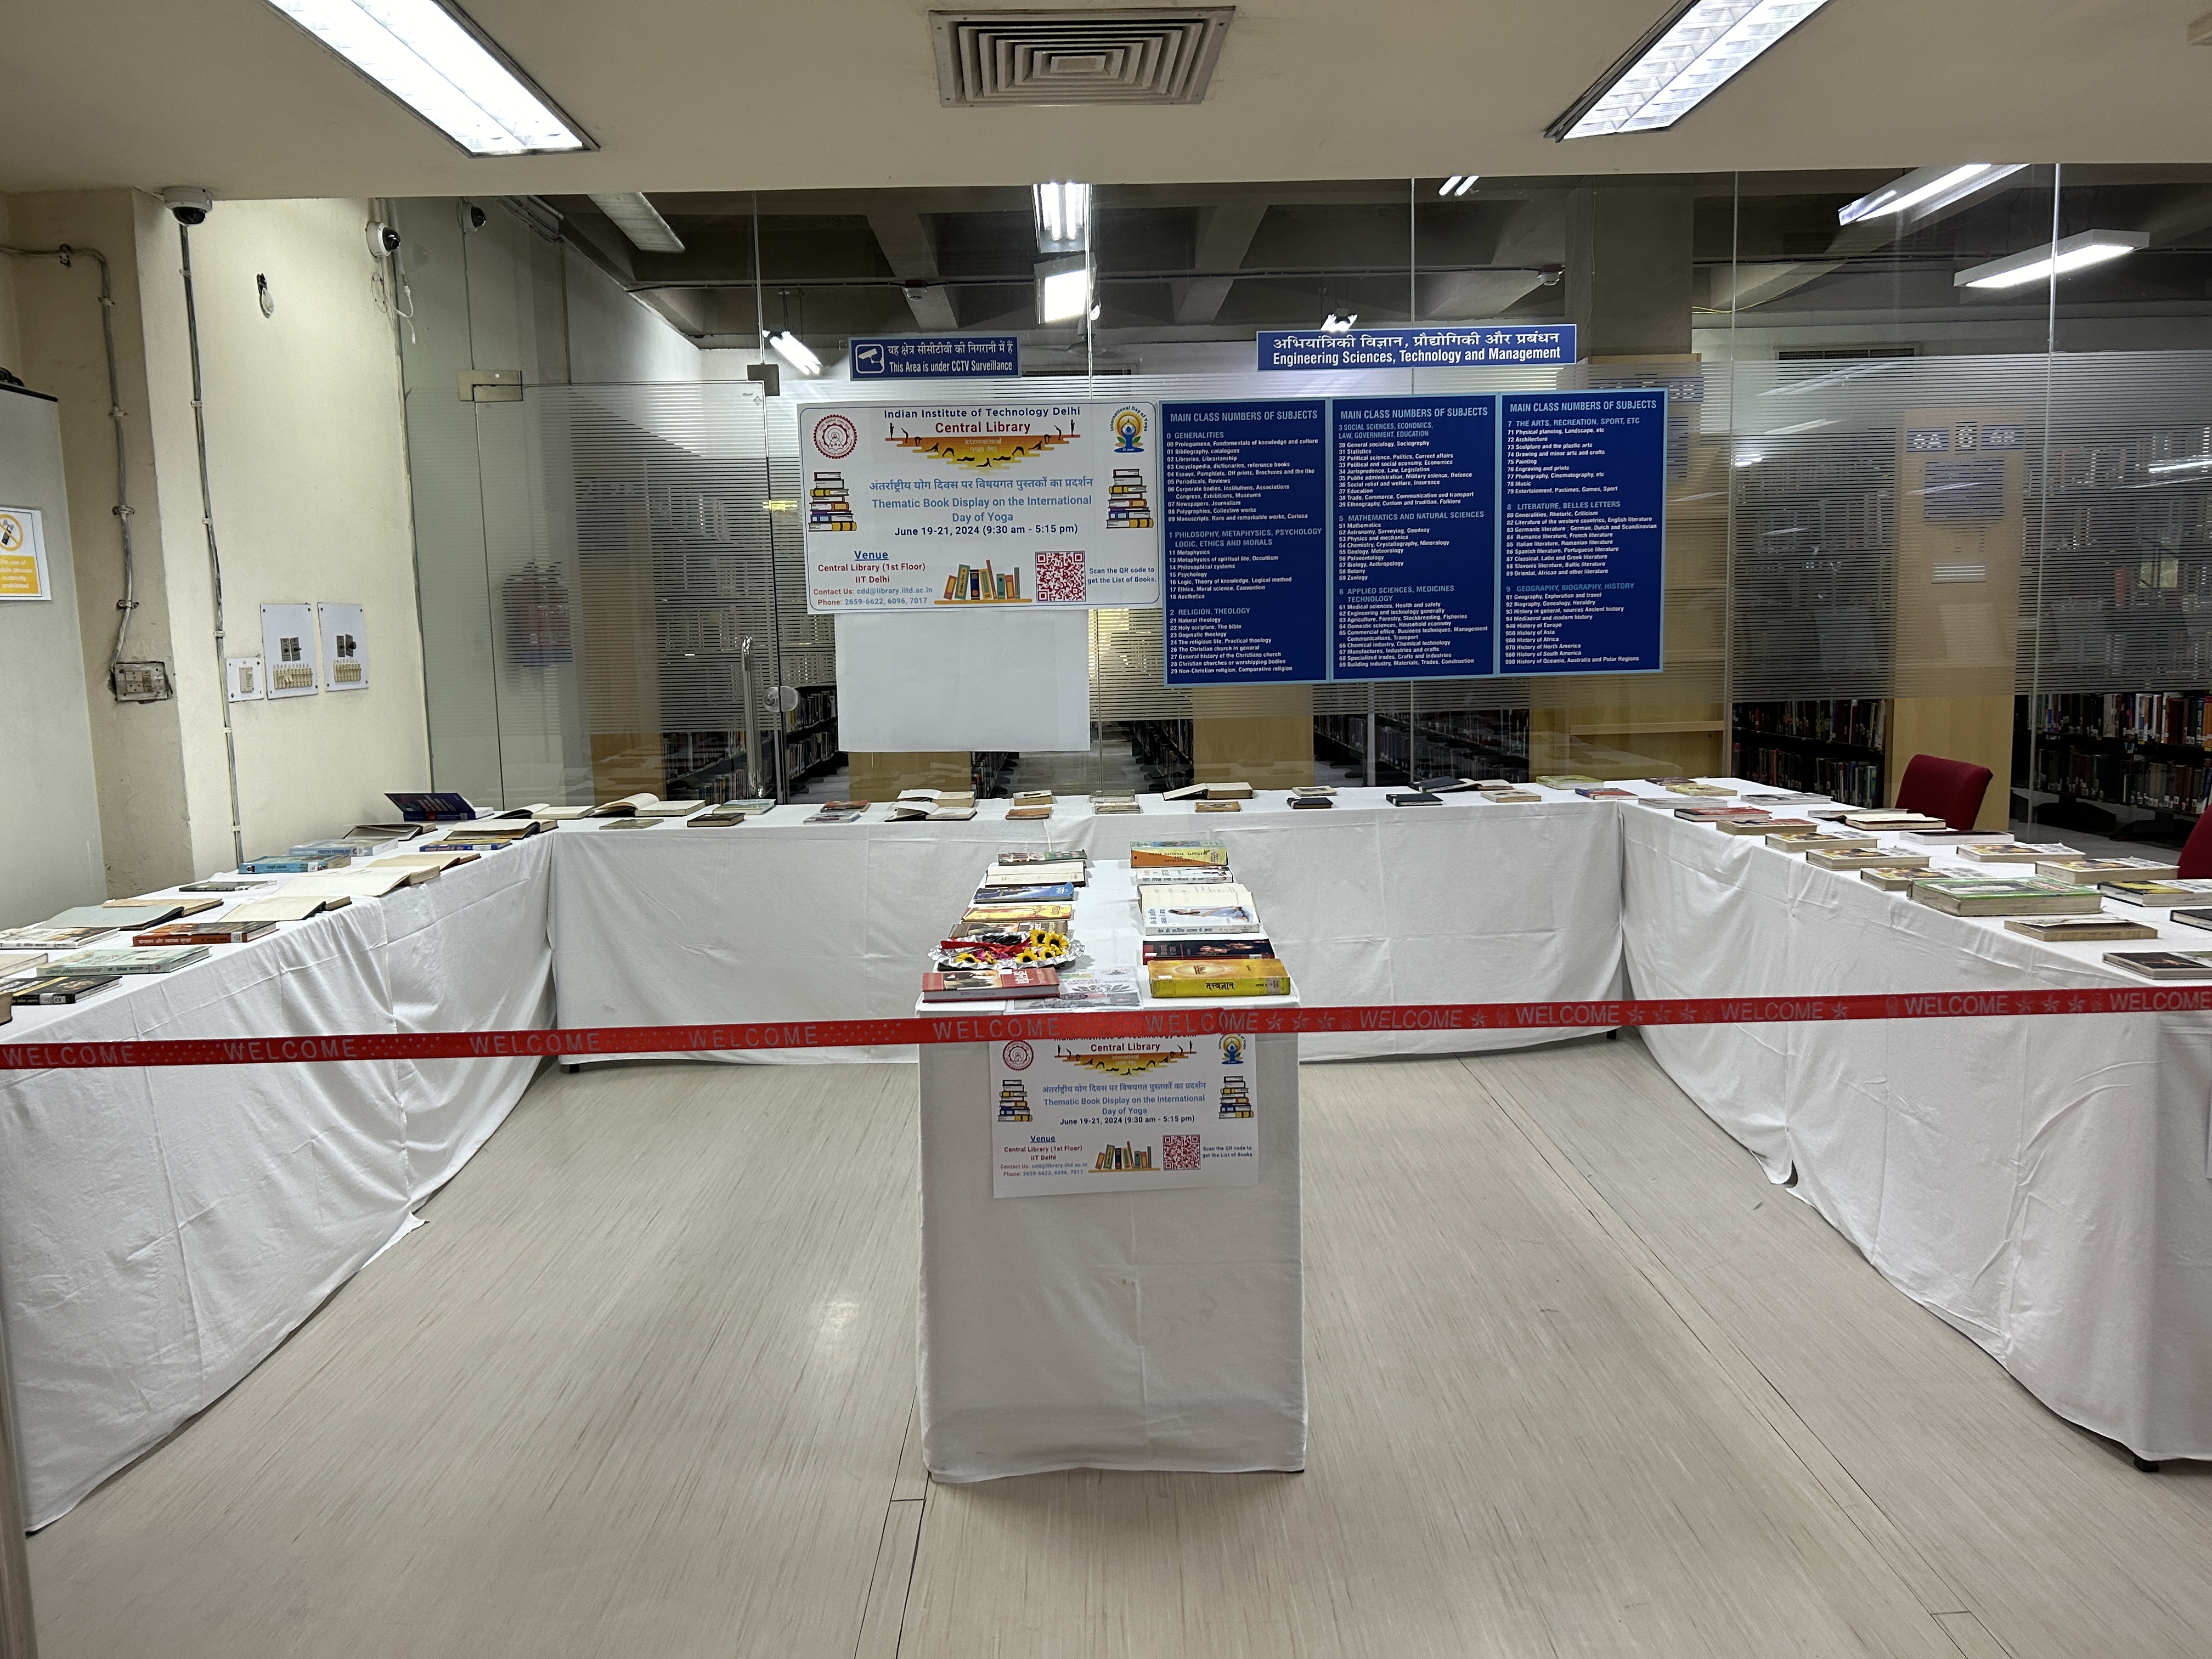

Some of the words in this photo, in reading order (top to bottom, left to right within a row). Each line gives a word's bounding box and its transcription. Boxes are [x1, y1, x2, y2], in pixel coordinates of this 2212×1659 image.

[1273, 335, 1356, 348] अभियांत्रिकी
[1412, 331, 1481, 346] प्रौद्योगिकी
[1485, 331, 1512, 344] और
[1515, 331, 1560, 343] प्रबंधन
[887, 346, 899, 356] यह
[901, 342, 915, 356] क्षेत्र
[916, 341, 952, 354] सीसीटीवी
[953, 341, 966, 353] की
[967, 341, 996, 353] निगरानी
[1272, 352, 1338, 366] Engineering
[1342, 351, 1395, 363] Sciences,
[1399, 349, 1462, 363] Technology
[1465, 348, 1485, 360] and
[1488, 347, 1560, 361] Management
[889, 362, 904, 373] This
[905, 362, 921, 372] Area
[922, 361, 929, 372] is
[930, 361, 950, 372] under
[951, 360, 969, 371] CCTV
[971, 360, 1012, 371] Surveillance
[1510, 403, 1531, 412] MAIN
[1533, 402, 1559, 411] CLASS
[1561, 401, 1601, 410] NUMBERS
[1603, 400, 1614, 410] OF
[1616, 400, 1656, 409] SUBJECTS
[884, 409, 917, 418] Indian
[922, 409, 967, 417] Institute
[970, 408, 981, 416] of
[985, 408, 1048, 417] Technology
[1053, 407, 1080, 415] Delhi
[1170, 413, 1191, 422] MAIN
[1193, 413, 1220, 422] CLASS
[1222, 411, 1261, 421] NUMBERS
[1264, 411, 1274, 420] OF
[1277, 410, 1318, 420] SUBJECTS
[1340, 410, 1361, 419] MAIN
[1364, 409, 1390, 419] CLASS
[1392, 408, 1432, 418] NUMBERS
[1434, 408, 1445, 417] OF
[1447, 407, 1488, 416] SUBJECTS
[935, 421, 981, 433] Central
[986, 421, 1030, 434] Library
[869, 479, 911, 492] अंतर्राष्ट्रीय
[913, 478, 931, 489] योग
[933, 478, 958, 489] दिवस
[961, 481, 973, 489] पर
[975, 478, 1013, 488] विषयगत
[1015, 476, 1047, 490] पुस्तकों
[1049, 479, 1063, 487] का
[1064, 476, 1093, 487] प्रदर्शन
[871, 499, 920, 508] Thematic
[923, 498, 949, 507] Book
[952, 497, 989, 509] Display
[1008, 496, 1024, 506] the
[1027, 495, 1091, 505] International
[952, 513, 971, 524] Day
[974, 512, 985, 522] of
[987, 512, 1013, 523] Yoga
[894, 527, 918, 535] June
[921, 527, 952, 536] 19-21,
[955, 526, 979, 534] 2024
[983, 525, 1007, 536] (9:30
[1035, 524, 1056, 533] 5:15
[1059, 523, 1077, 534] pm)
[854, 551, 889, 561] Venue
[850, 563, 879, 572] Library
[882, 563, 899, 572] (1st
[901, 562, 925, 571] Floor)
[2, 1045, 137, 1067] WELCOME
[225, 1039, 357, 1060] WELCOME
[470, 1032, 601, 1054] WELCOME
[689, 1025, 819, 1047] WELCOME
[933, 1017, 1062, 1040] WELCOME
[1146, 1012, 1258, 1034] WELCOME
[1359, 1009, 1463, 1029] WELCOME
[1515, 1005, 1620, 1025] WELCOME
[1720, 1001, 1824, 1021] WELCOME
[1904, 995, 2008, 1015] WELCOME
[2110, 991, 2211, 1011] WELCOME
[1091, 1043, 1124, 1052] Central
[1127, 1043, 1160, 1052] Library
[1102, 1108, 1116, 1116] Day
[1128, 1107, 1147, 1115] Yoga
